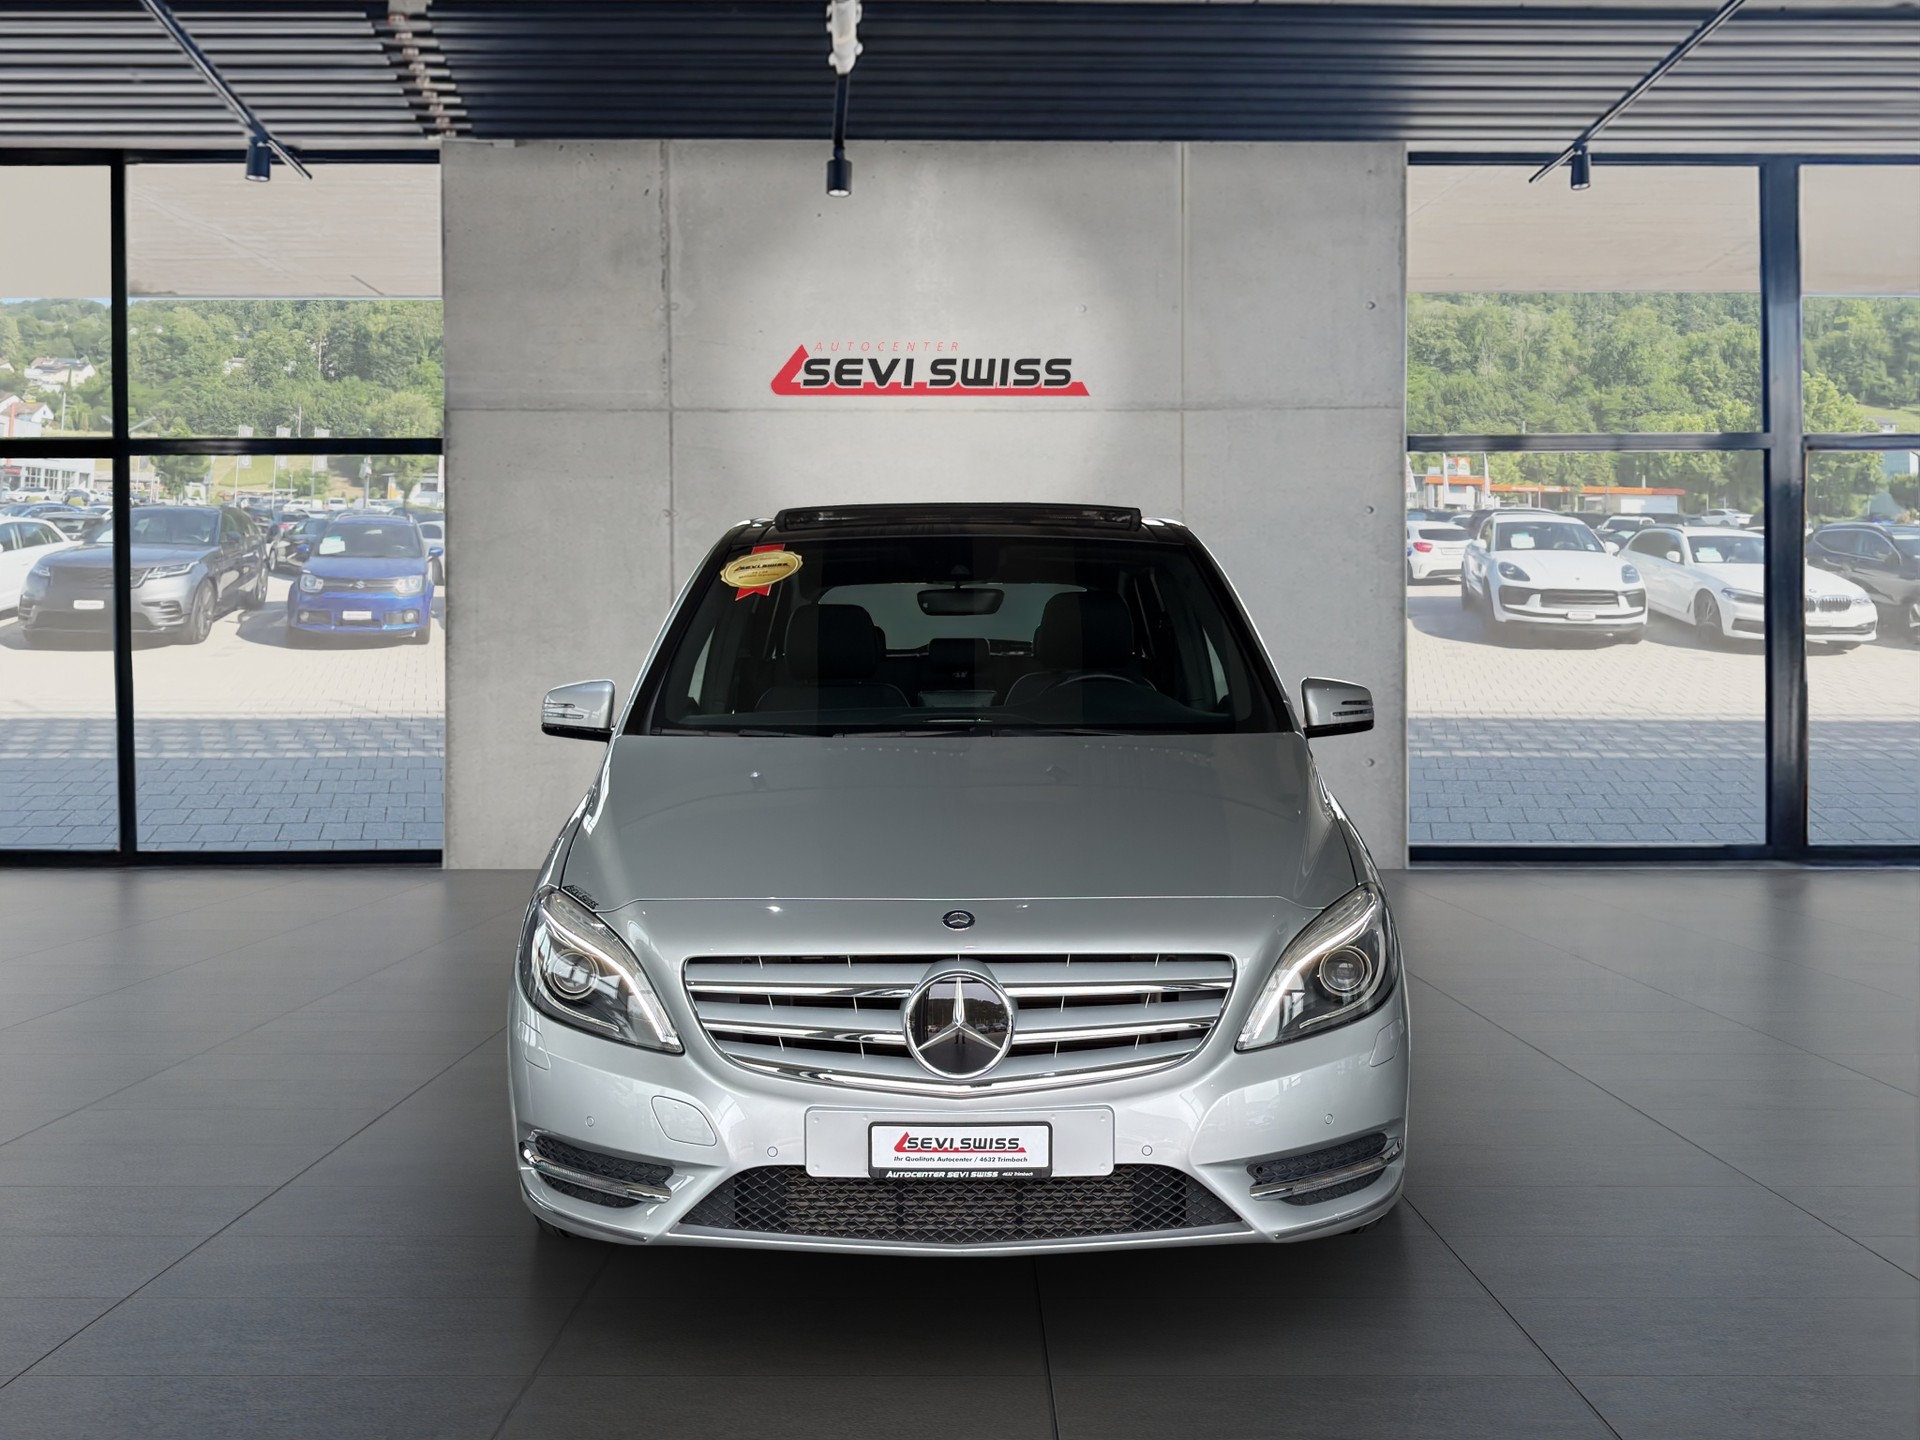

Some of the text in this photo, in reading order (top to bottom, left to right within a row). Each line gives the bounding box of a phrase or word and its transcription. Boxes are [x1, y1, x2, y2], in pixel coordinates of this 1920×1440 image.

[813, 341, 960, 352] AUTOCENTER
[802, 358, 1072, 387] SEVI SWISS
[907, 1137, 1020, 1149] SEVI SWISS
[947, 1170, 969, 1178] SEVI
